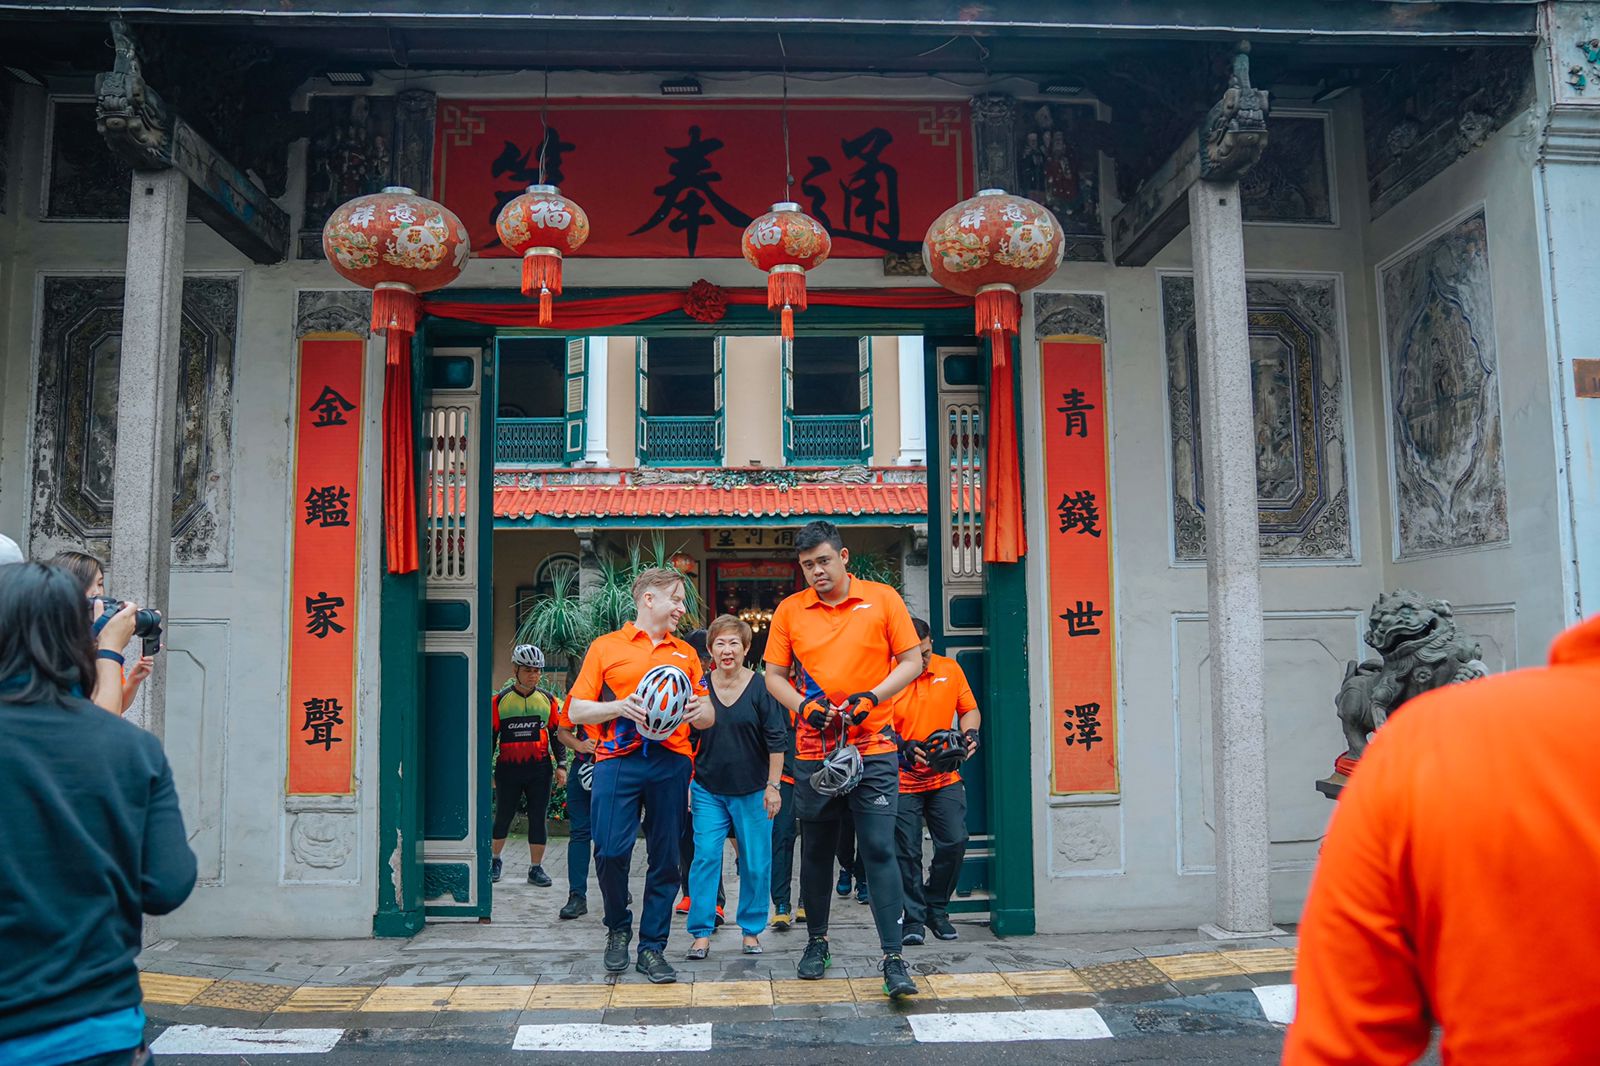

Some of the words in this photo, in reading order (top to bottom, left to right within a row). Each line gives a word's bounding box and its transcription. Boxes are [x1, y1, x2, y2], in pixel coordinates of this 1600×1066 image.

[530, 200, 572, 230] 福
[748, 216, 782, 249] 福
[507, 721, 539, 729] GIANT
